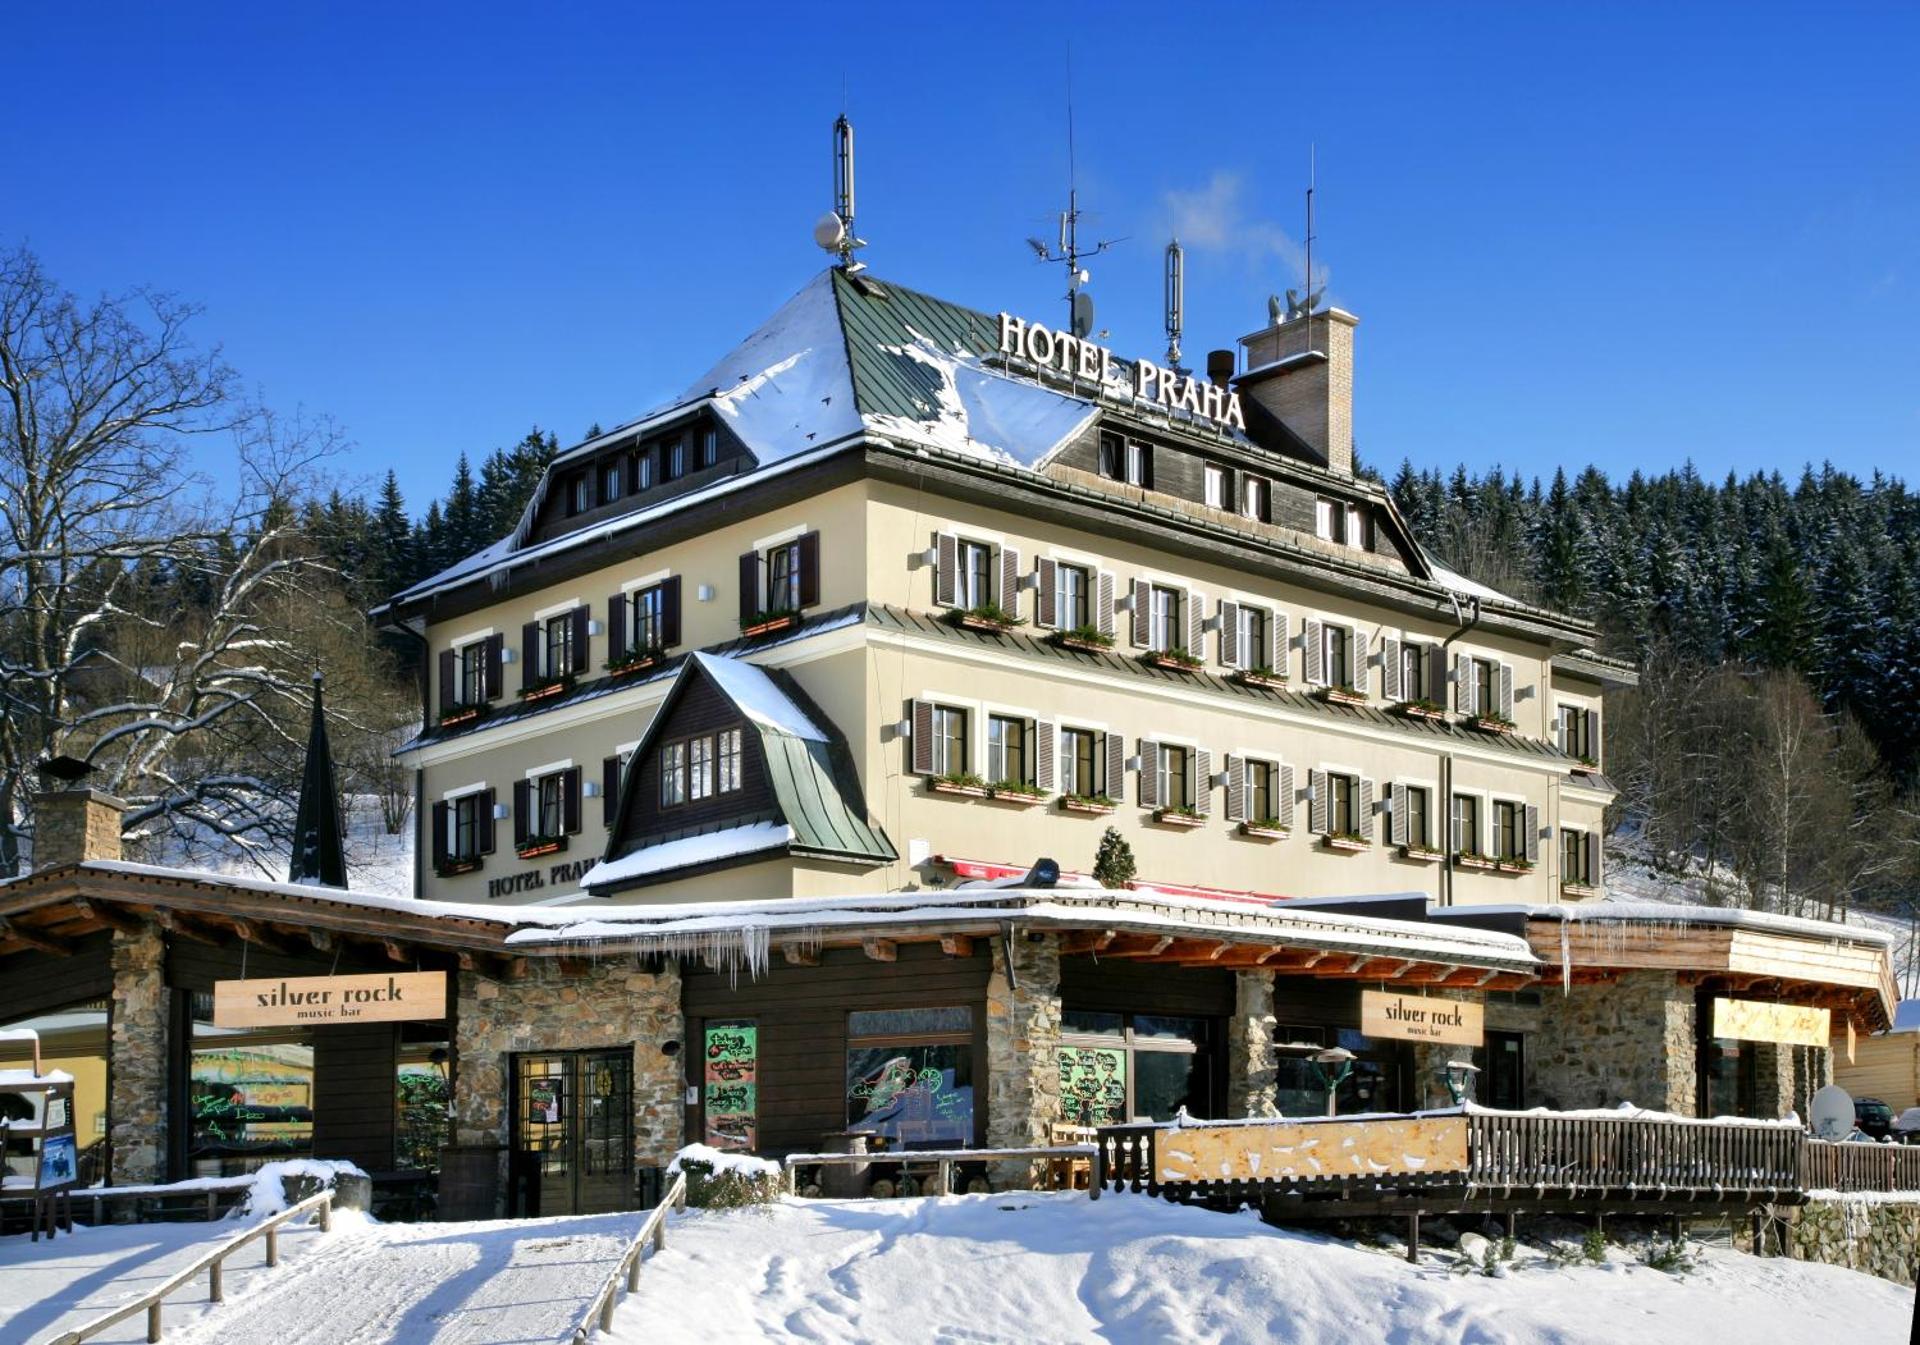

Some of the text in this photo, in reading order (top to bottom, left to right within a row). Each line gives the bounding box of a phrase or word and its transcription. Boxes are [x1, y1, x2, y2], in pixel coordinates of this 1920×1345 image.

[1000, 312, 1245, 429] HOTEL PRAHA
[489, 857, 603, 896] HOTEL PRAH
[257, 977, 403, 1007] silver rock
[297, 1005, 362, 1018] music bar
[1386, 998, 1462, 1026] silver rock
[1407, 1024, 1442, 1037] music bar
